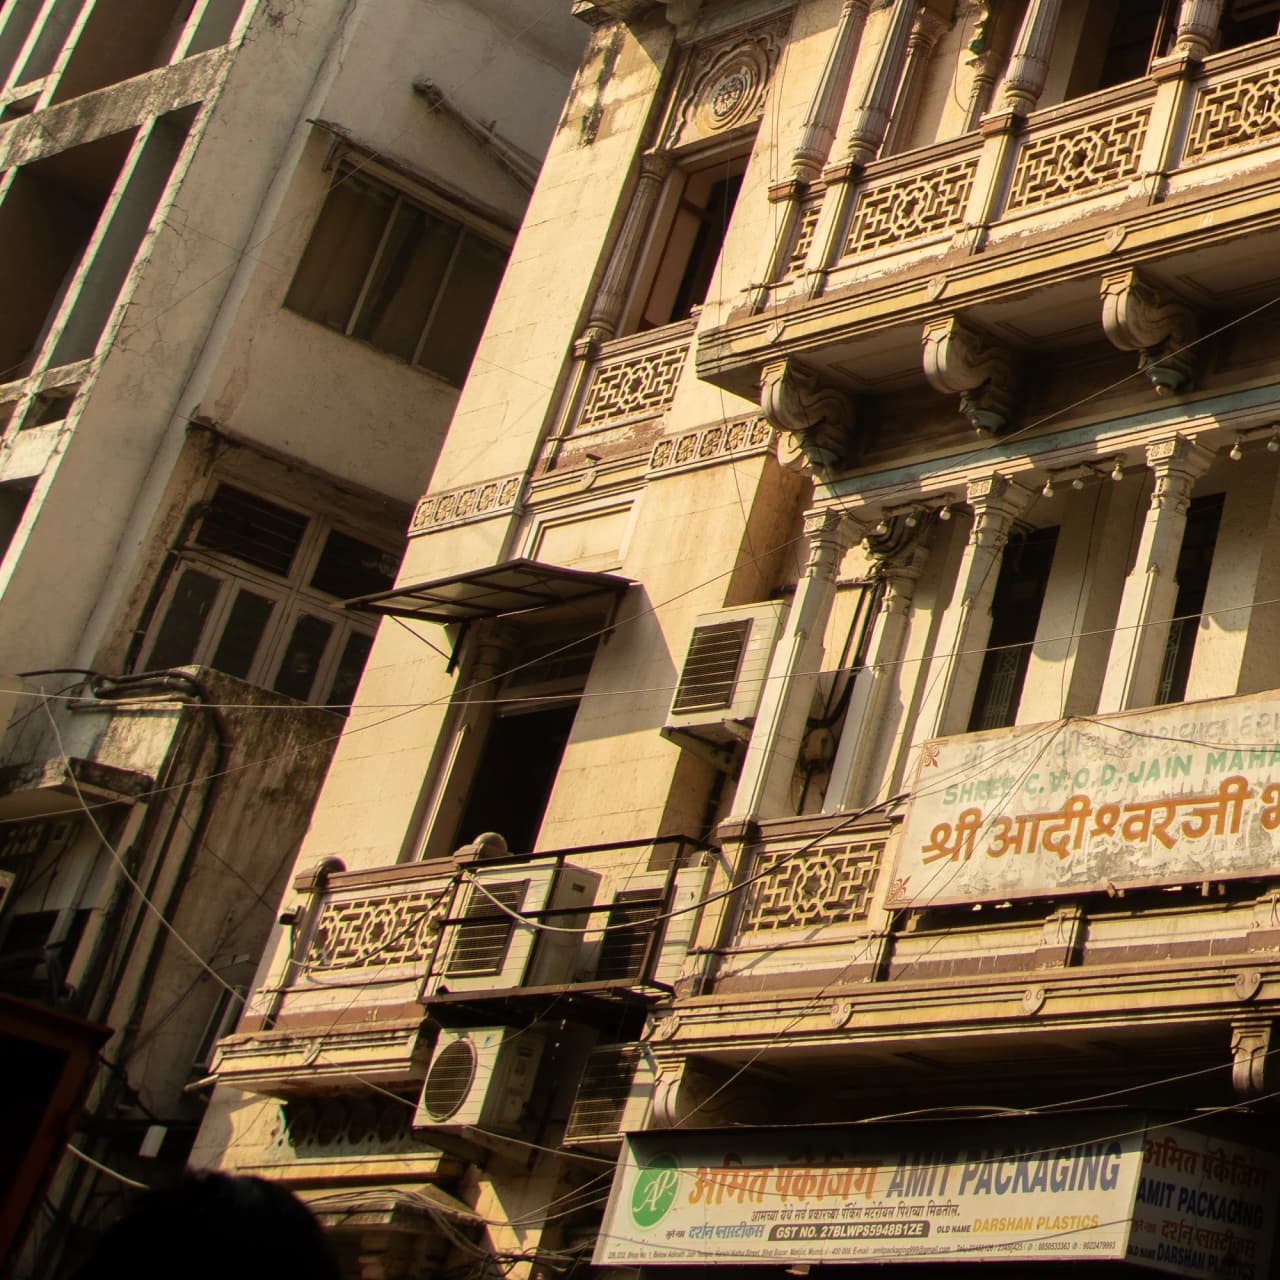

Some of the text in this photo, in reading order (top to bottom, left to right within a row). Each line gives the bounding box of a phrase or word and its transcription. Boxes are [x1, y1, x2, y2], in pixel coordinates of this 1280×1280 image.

[1128, 754, 1193, 784] JAIN
[921, 807, 983, 865] श्री
[986, 776, 1251, 861] आदीश्वरजी
[886, 1141, 1122, 1199] AMIT PACKAGING
[936, 1214, 1100, 1234] OLD NAME DARSHAN PLASTICS
[1137, 1177, 1264, 1230] AMIT PACKAGING
[776, 1227, 798, 1239] GST
[799, 1226, 819, 1238] NO.
